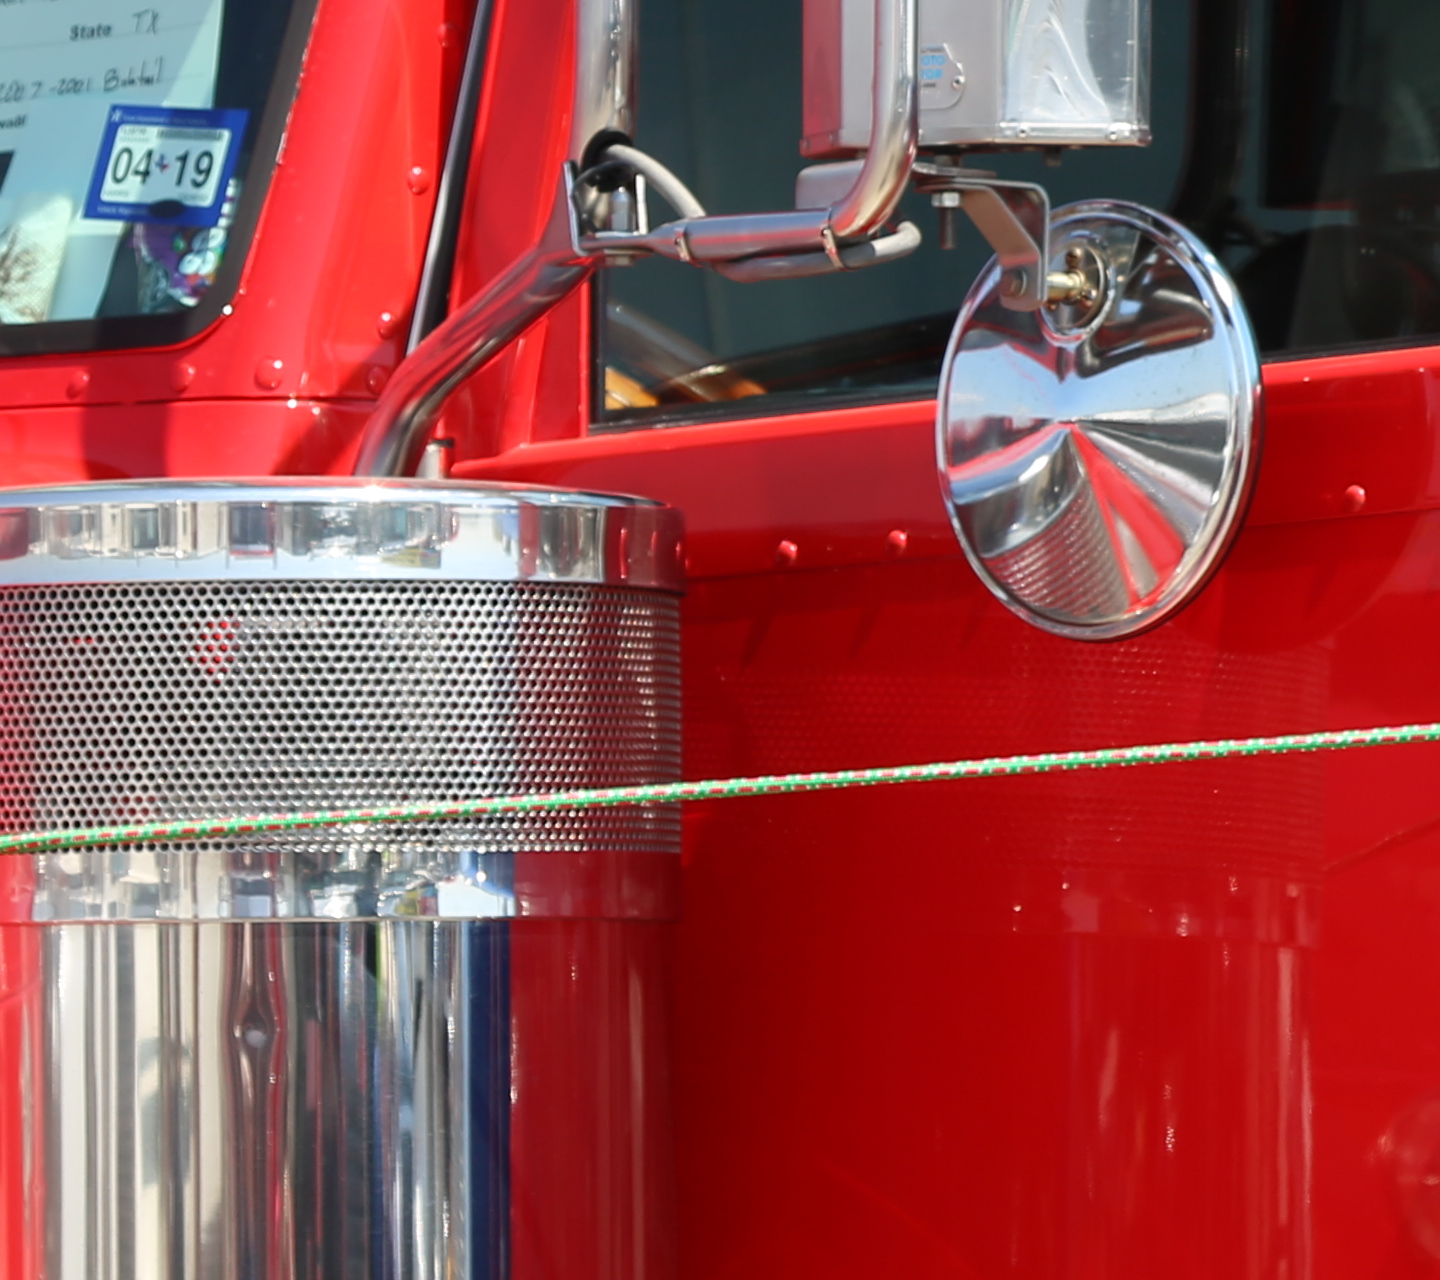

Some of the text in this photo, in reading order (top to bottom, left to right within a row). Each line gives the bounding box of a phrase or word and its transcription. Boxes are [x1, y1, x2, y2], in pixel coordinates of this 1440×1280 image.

[69, 24, 112, 41] State
[133, 8, 159, 36] TX
[111, 147, 214, 189] 04 19
